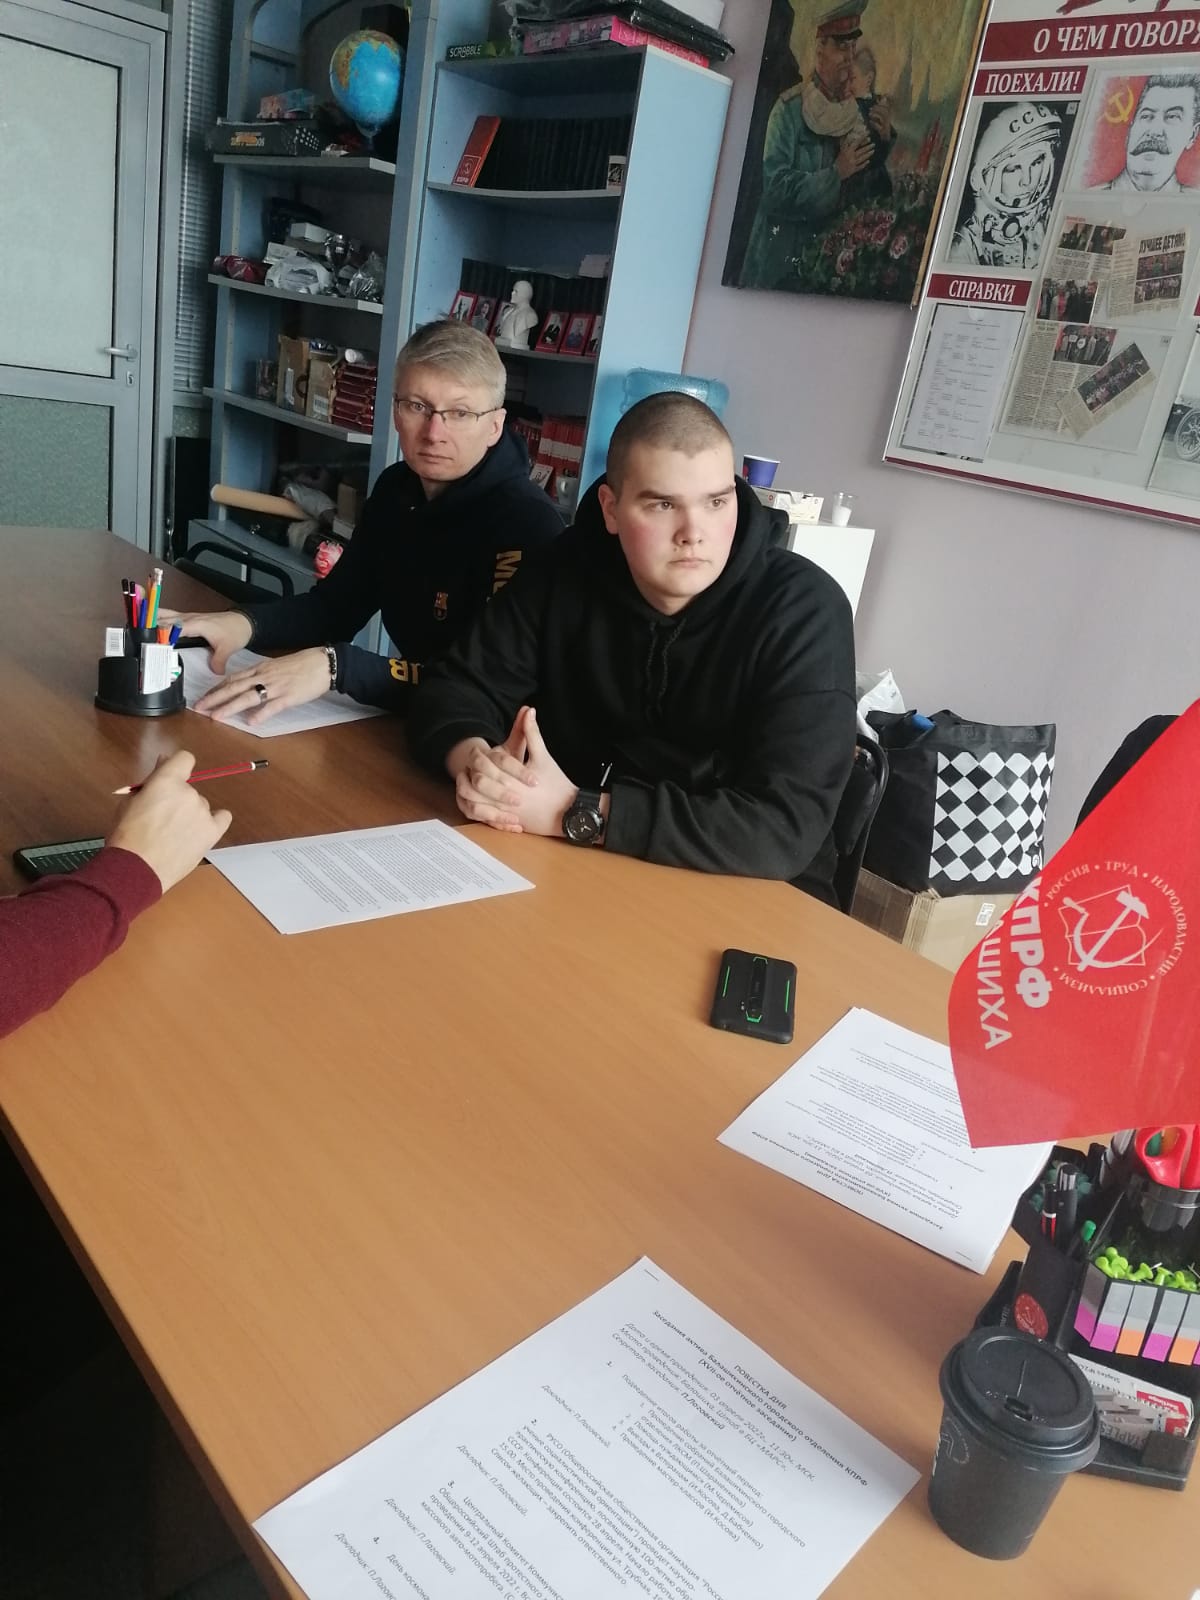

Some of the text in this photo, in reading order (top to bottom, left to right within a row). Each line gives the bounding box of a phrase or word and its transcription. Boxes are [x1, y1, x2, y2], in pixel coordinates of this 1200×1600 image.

[448, 44, 483, 58] SCRABBLE
[1033, 28, 1050, 53] О
[1057, 25, 1107, 52] ЧЕМ
[985, 70, 1080, 94] ПОЕХАЛИ!
[949, 280, 1016, 302] СПРАВКИ
[1046, 860, 1188, 997] РОССИЯ ТРУД НАРОДОВЛАСТИЕ СОЦИАЛИЗМ
[611, 1332, 646, 1363] Секретарь
[618, 1327, 643, 1347] Место
[715, 1409, 741, 1430] Штаб
[743, 1433, 757, 1445] БЦ
[621, 1373, 658, 1407] Подведение
[656, 1405, 677, 1424] итогов
[675, 1423, 699, 1444] работы
[685, 1337, 708, 1356] актива
[707, 1353, 764, 1403] Балашихинского
[763, 1402, 804, 1436] городского
[804, 1435, 844, 1468] отделения
[844, 1466, 868, 1486] КПРФ
[709, 1392, 721, 1401] 03
[718, 1400, 745, 1422] апреля
[733, 1364, 787, 1410] ПОВЕСТКА ДНЯ
[626, 1426, 651, 1450] Выезды
[654, 1451, 689, 1482] Ветеранам
[633, 1420, 659, 1445] Помощь
[658, 1443, 704, 1484] нуждающимся
[640, 1415, 673, 1444] отделения
[671, 1443, 692, 1461] ЛКСМ
[755, 1407, 797, 1442] заседание)
[490, 1447, 512, 1470] Список
[510, 1468, 543, 1502] желающих
[546, 1505, 578, 1537] закрепить
[515, 1458, 536, 1479] Место
[534, 1478, 571, 1515] проведения
[569, 1513, 613, 1556] конференции
[619, 1431, 657, 1467] Проведение
[656, 1465, 705, 1510] мастер-классов
[647, 1409, 685, 1443] Проведение
[683, 1441, 715, 1468] собраний
[713, 1466, 768, 1514] Балашихинского
[766, 1512, 806, 1548] городского
[420, 1500, 451, 1534] массового
[429, 1493, 466, 1533] проведении
[463, 1530, 480, 1547] 9-12
[476, 1545, 501, 1571] апреля
[498, 1568, 517, 1587] 2022
[438, 1487, 542, 1596] Общероссийский Штаб протестного
[447, 1480, 564, 1600] 3. Центральный Комитет Коммунис
[515, 1430, 555, 1470] практическую
[596, 1510, 641, 1554] посвященную
[640, 1552, 676, 1587] 100-летию
[675, 1586, 690, 1600] обр
[522, 1451, 563, 1492] Конференция
[561, 1490, 592, 1521] состоится
[591, 1518, 602, 1529] 28
[624, 1551, 650, 1577] Начало
[543, 1445, 598, 1497] социалистической
[668, 1565, 695, 1591] научно-
[545, 1432, 563, 1450] РУСО
[560, 1448, 614, 1499] (Общероссийская
[612, 1497, 659, 1542] общественная
[657, 1539, 700, 1581] организация
[701, 1578, 723, 1600] "Росс
[385, 1553, 404, 1573] День
[402, 1571, 429, 1600] космона
